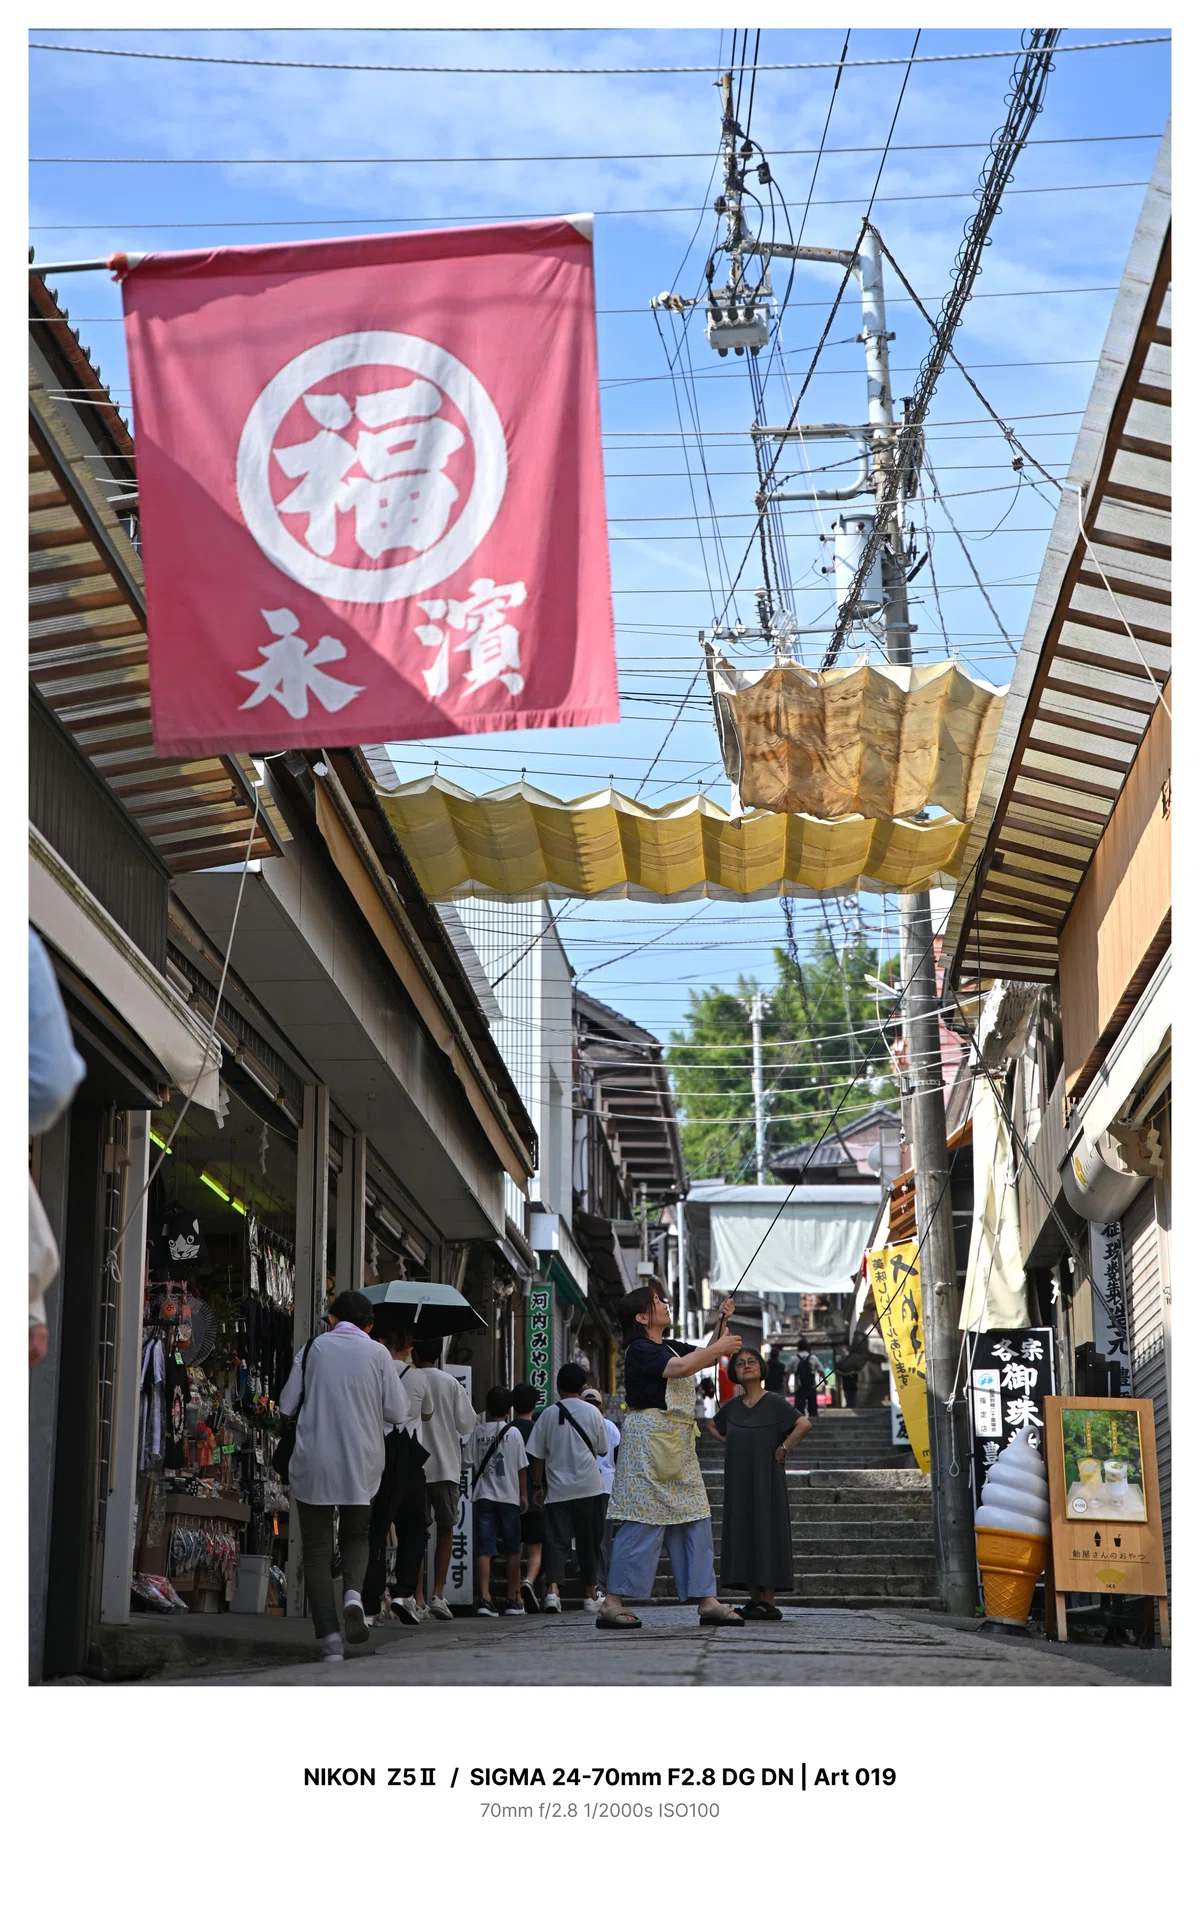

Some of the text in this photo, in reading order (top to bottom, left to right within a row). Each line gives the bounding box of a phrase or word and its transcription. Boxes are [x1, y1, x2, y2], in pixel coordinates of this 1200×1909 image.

[272, 379, 466, 559] 福
[1072, 1549, 1146, 1561] 飴屋さんのおやつ
